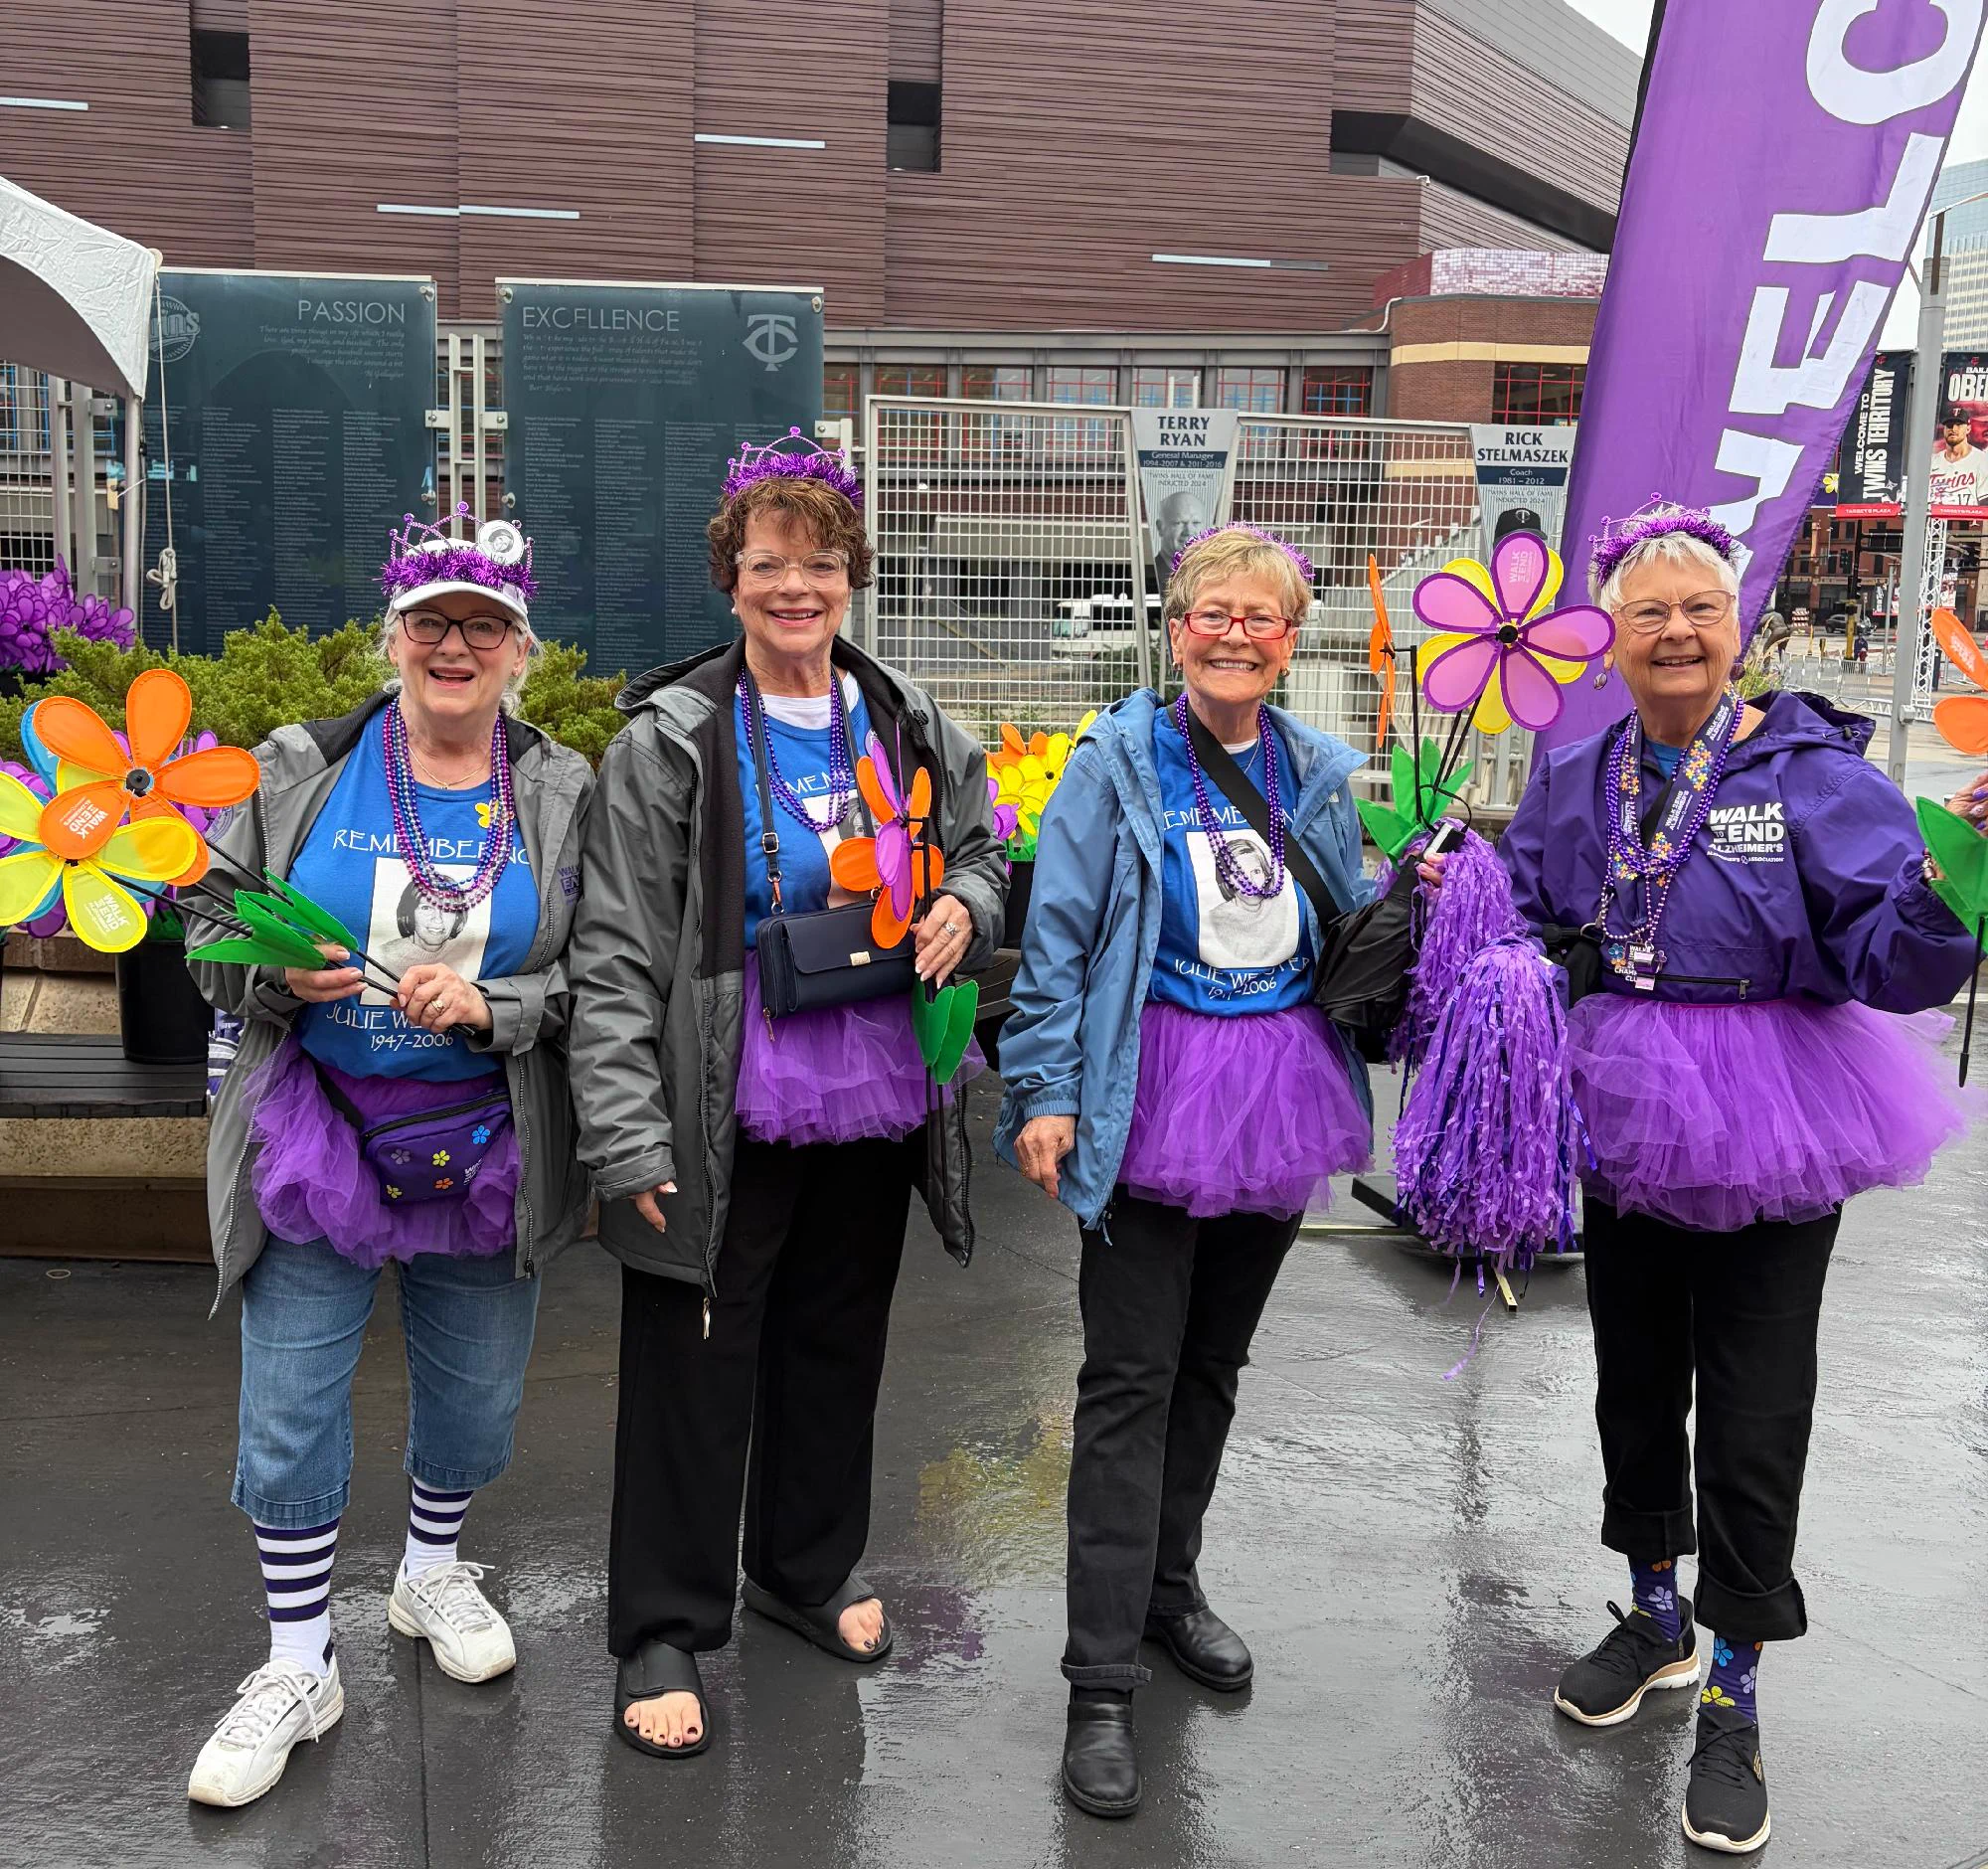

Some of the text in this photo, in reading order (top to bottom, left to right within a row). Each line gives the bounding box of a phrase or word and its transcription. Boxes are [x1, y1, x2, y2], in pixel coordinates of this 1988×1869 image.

[298, 300, 405, 324] PASSION
[1948, 373, 1988, 402] OBE
[1157, 416, 1210, 430] TERRY
[1855, 393, 1869, 474] WELCOME TO
[1863, 368, 1895, 498] TWINS TERRITORY
[1160, 432, 1207, 446] RYAN
[1505, 431, 1543, 445] RICK
[1181, 451, 1215, 461] Manager
[1477, 447, 1569, 463] STELMASZEK
[1509, 551, 1520, 583] WALK
[70, 810, 92, 832] END
[1710, 802, 1784, 824] WALK
[77, 810, 108, 840] WALK
[1728, 823, 1784, 843] END
[1708, 843, 1784, 854] ALZHEIMER'S
[99, 906, 119, 932] END
[103, 894, 131, 927] WALK
[1173, 958, 1226, 986] JULIE
[326, 1003, 388, 1030] JULIE
[371, 1030, 454, 1052] 1947-2006
